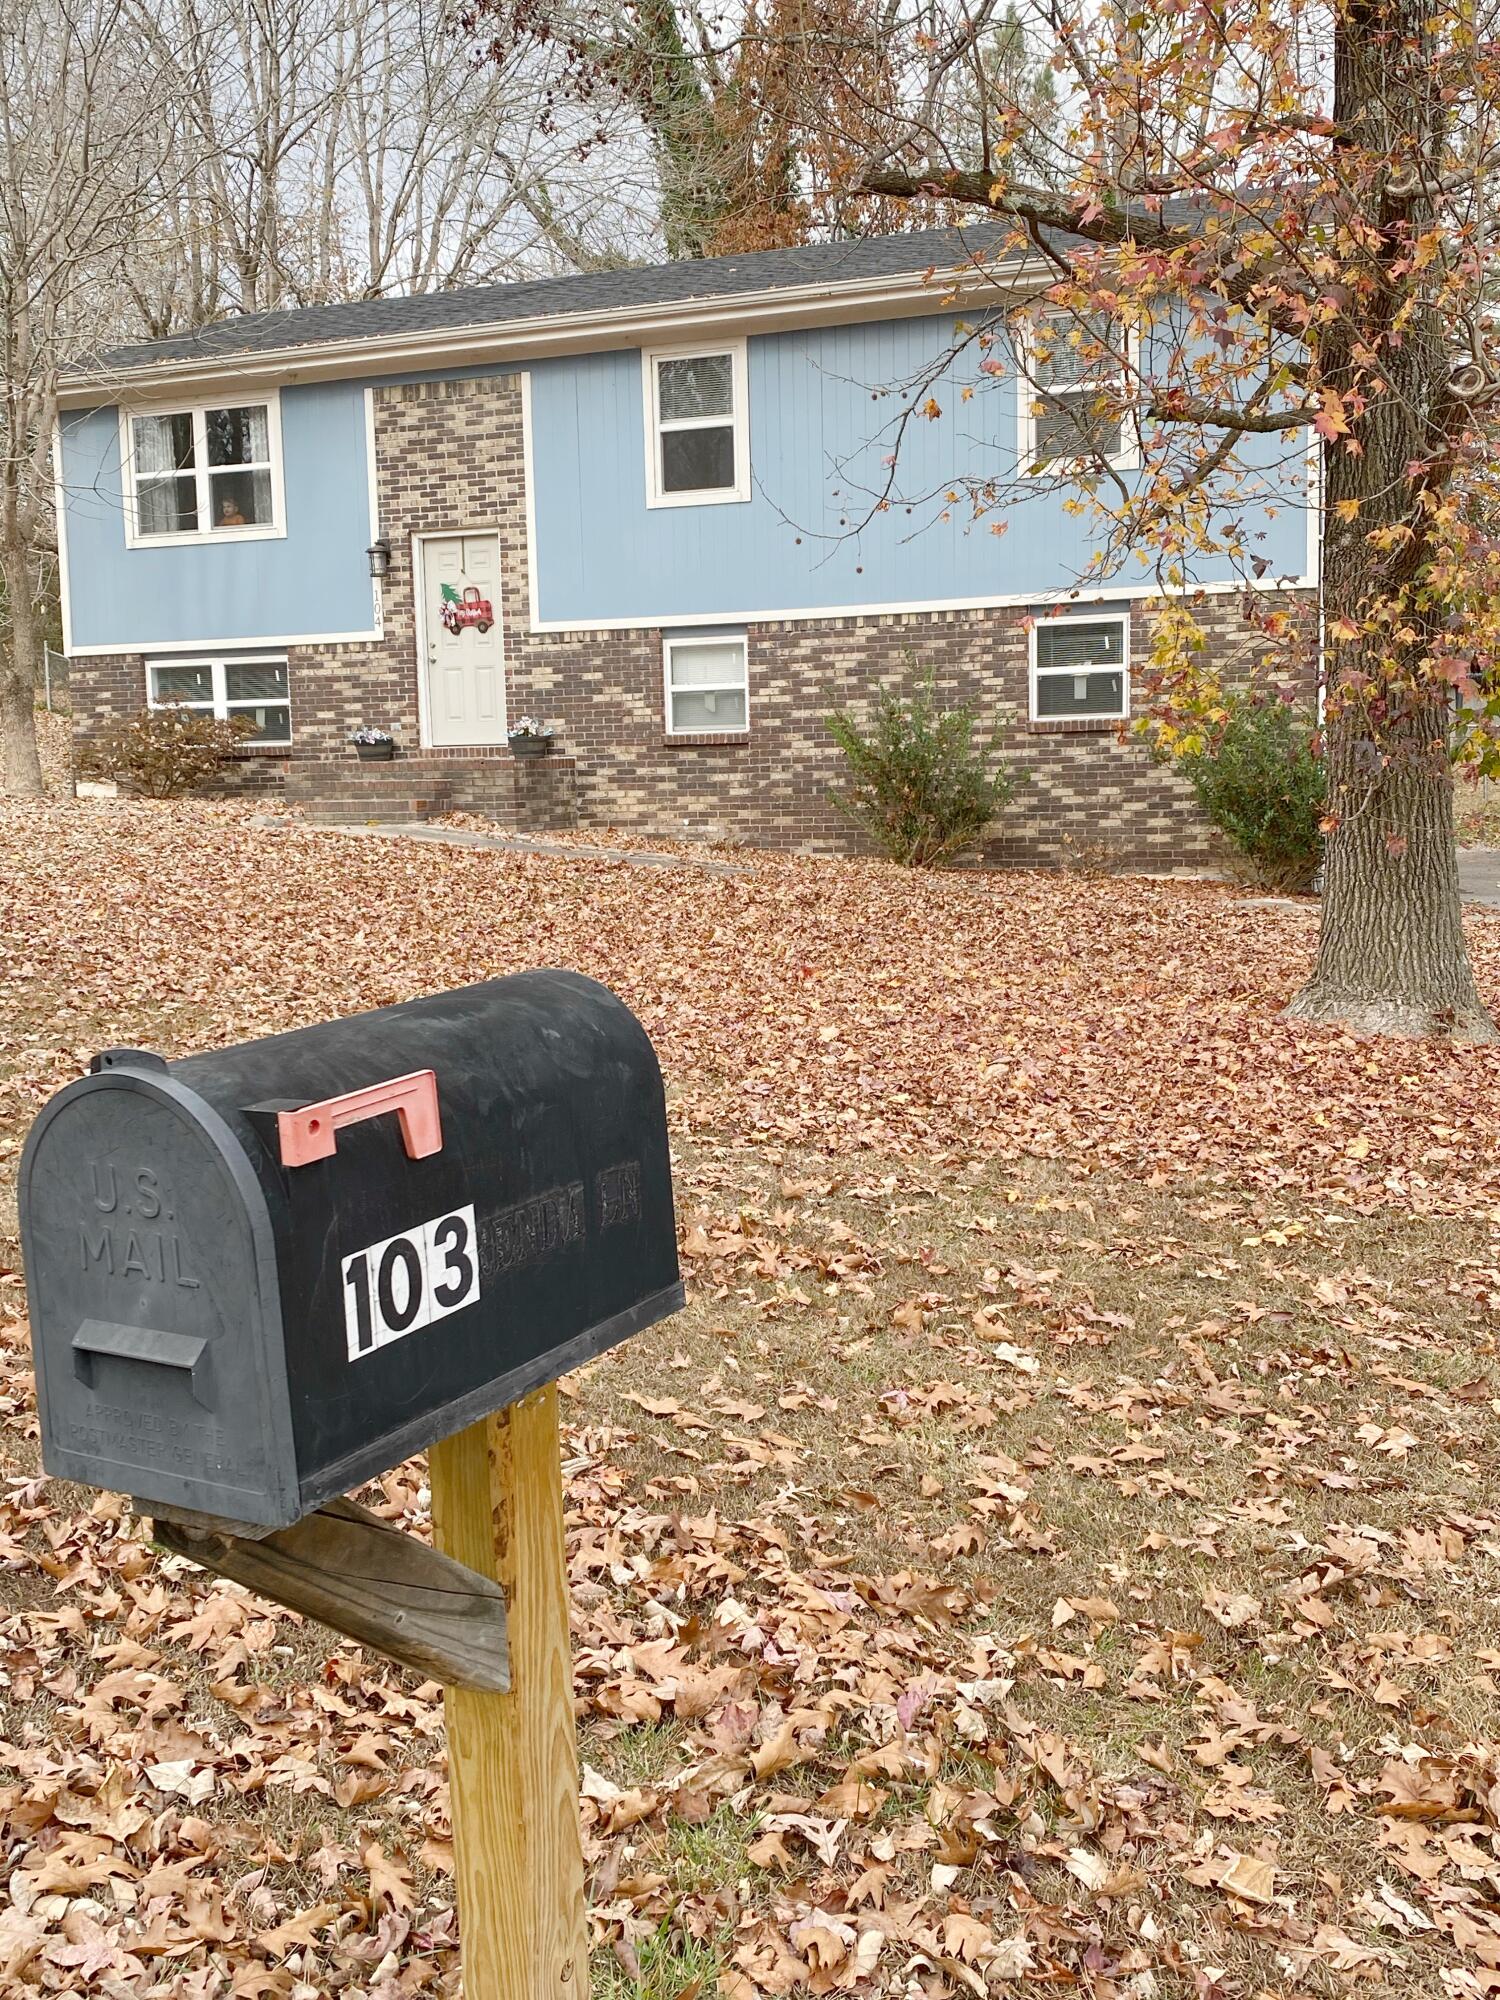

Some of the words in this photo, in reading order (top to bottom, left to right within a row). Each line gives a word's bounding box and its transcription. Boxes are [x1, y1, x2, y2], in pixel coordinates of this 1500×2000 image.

[374, 590, 382, 627] 104
[88, 1161, 174, 1220] U.S.
[80, 1221, 200, 1289] MAIL
[346, 1216, 473, 1352] 103
